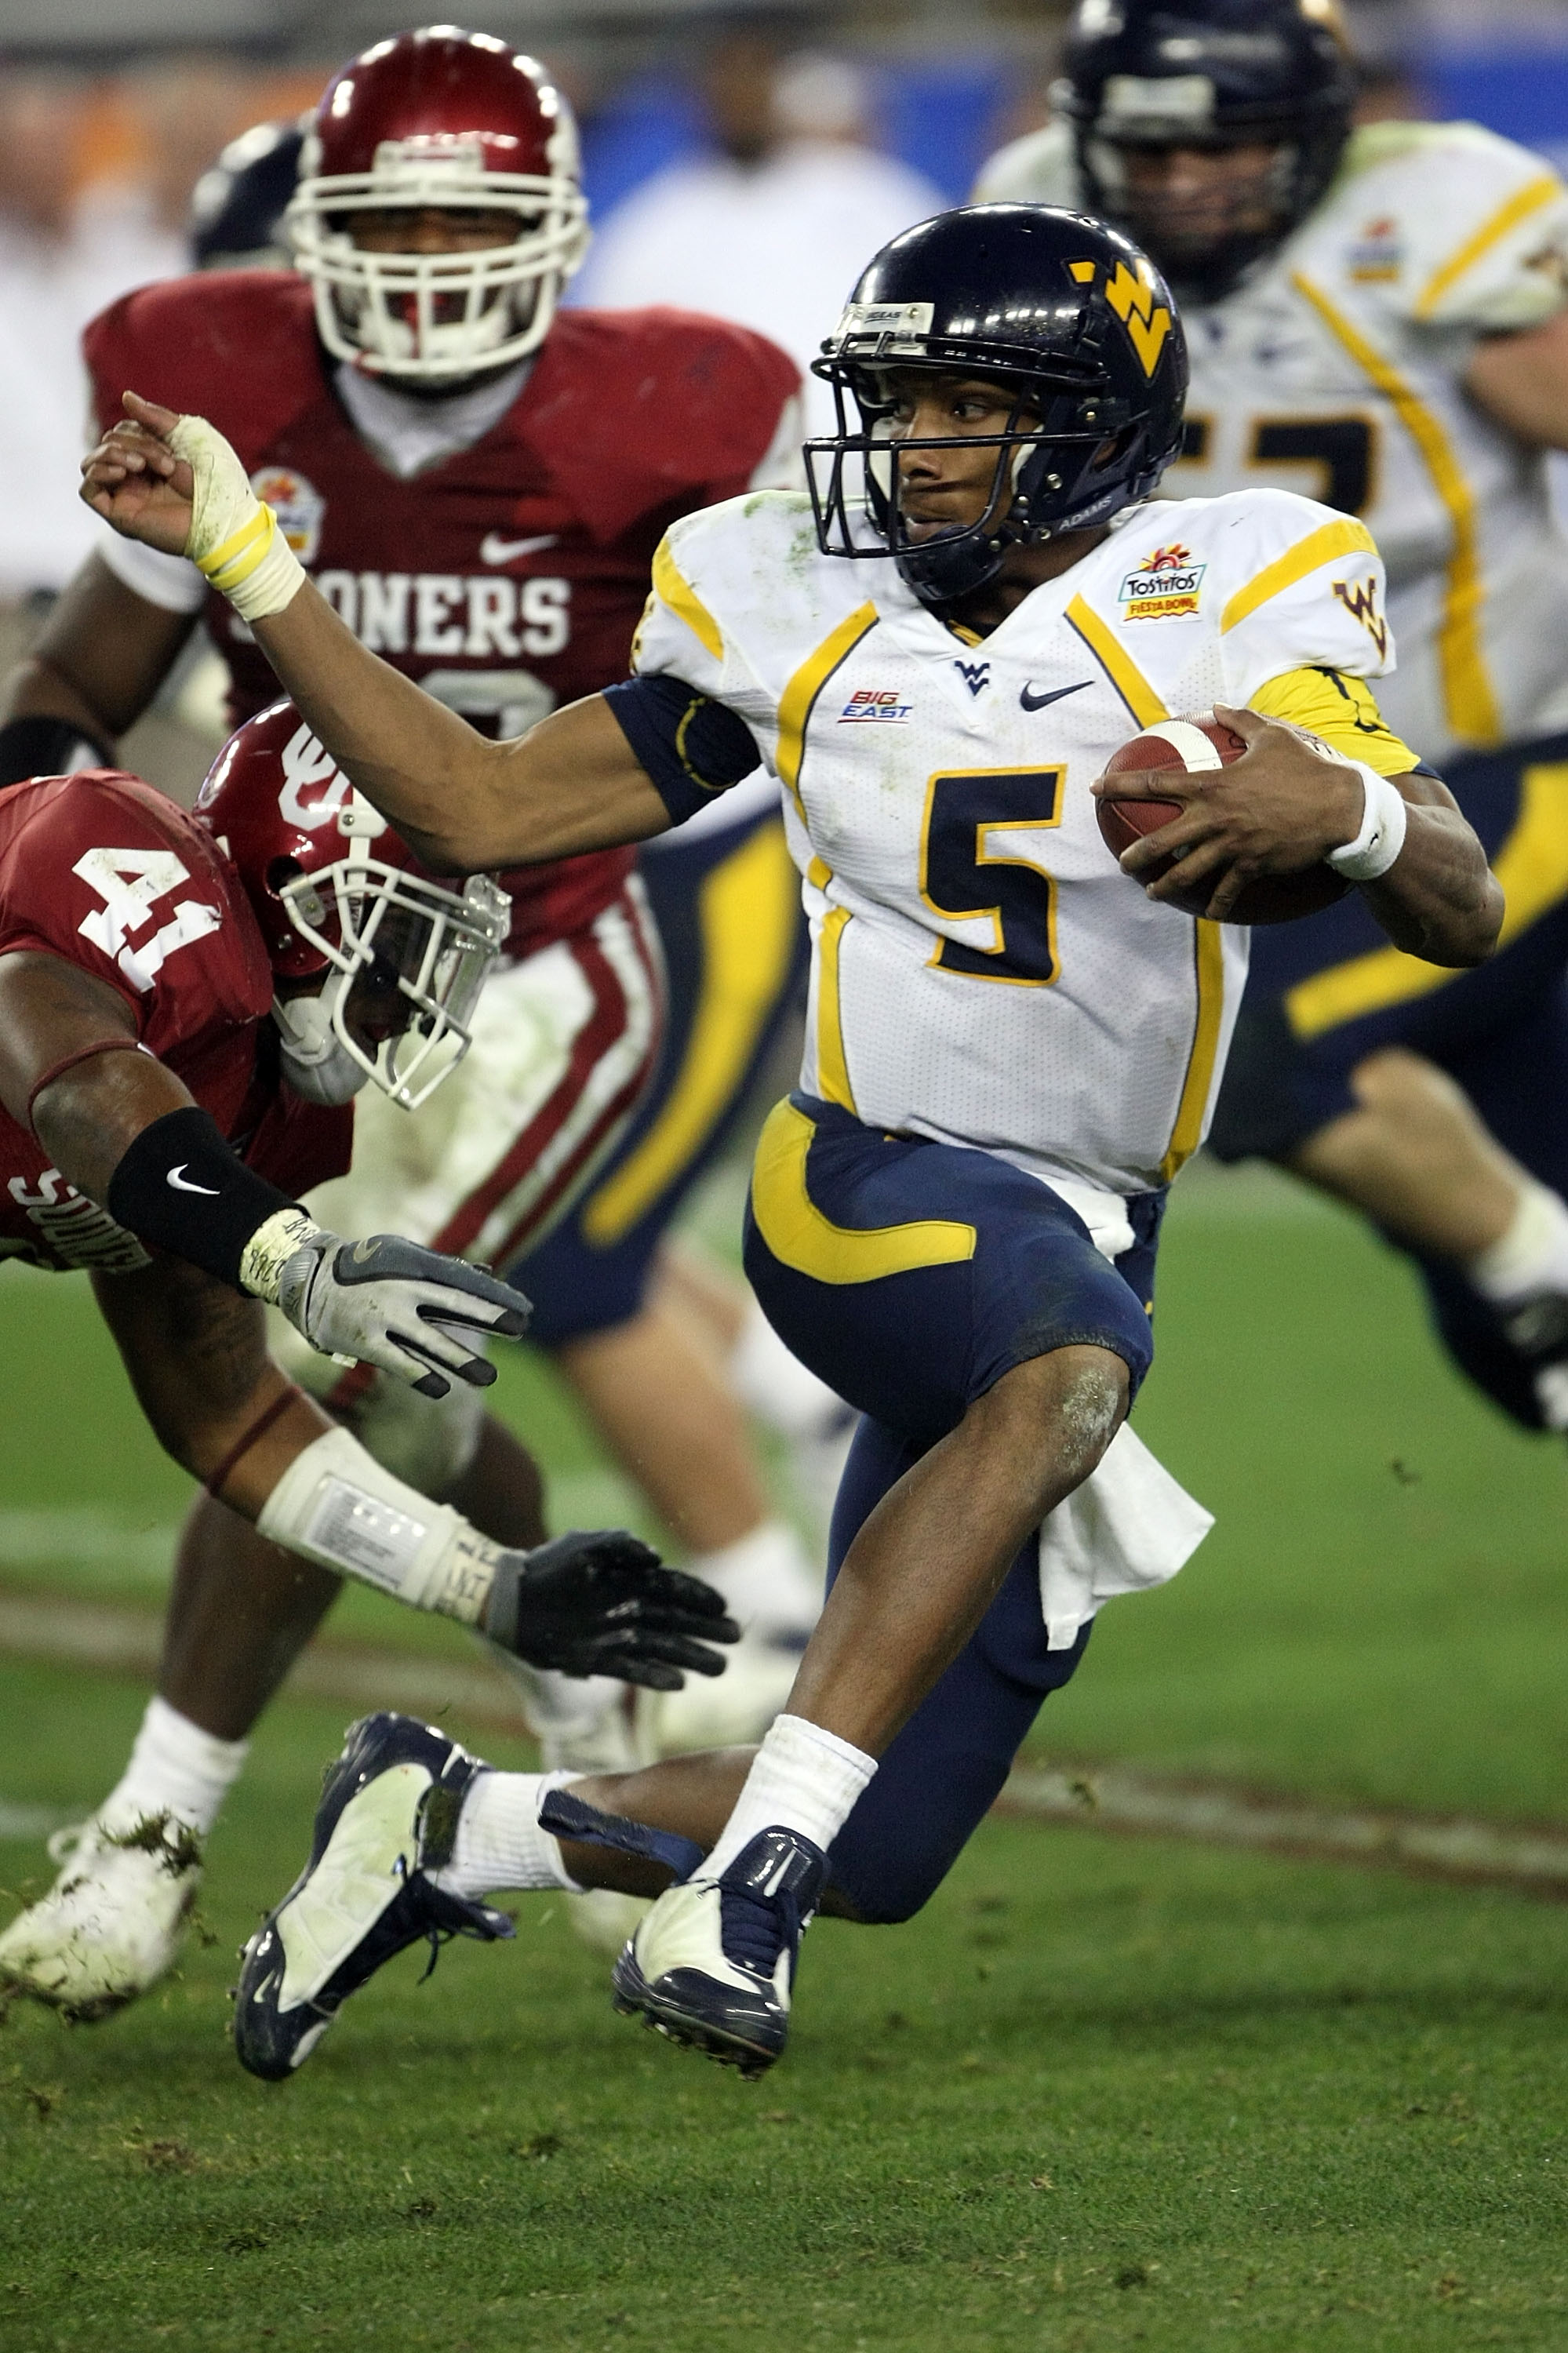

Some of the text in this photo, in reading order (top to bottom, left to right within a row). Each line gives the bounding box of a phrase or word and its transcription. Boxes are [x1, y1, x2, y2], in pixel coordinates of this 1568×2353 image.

[1058, 495, 1112, 531] ADAMS
[842, 705, 913, 718] EAST
[850, 690, 900, 705] BIG
[919, 763, 1068, 987] 5
[72, 848, 223, 993] 41
